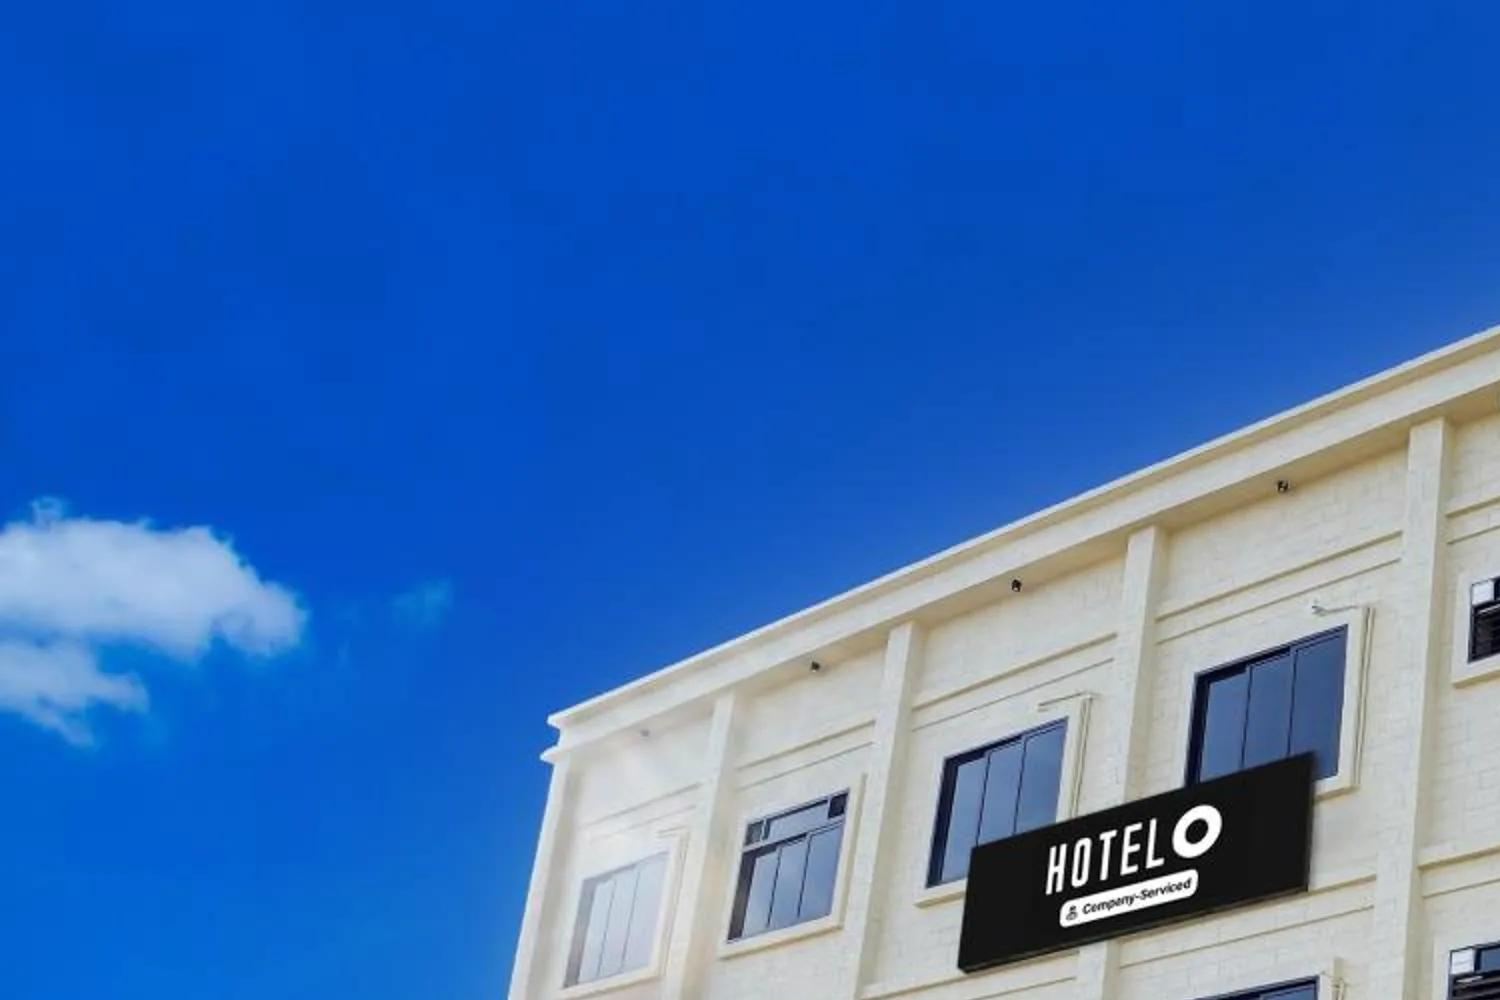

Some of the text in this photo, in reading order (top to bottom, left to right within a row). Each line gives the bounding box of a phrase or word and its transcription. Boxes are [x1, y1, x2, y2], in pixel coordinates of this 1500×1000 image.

[1046, 804, 1222, 895] HOTEL O
[1082, 877, 1192, 915] Company-Serviced
